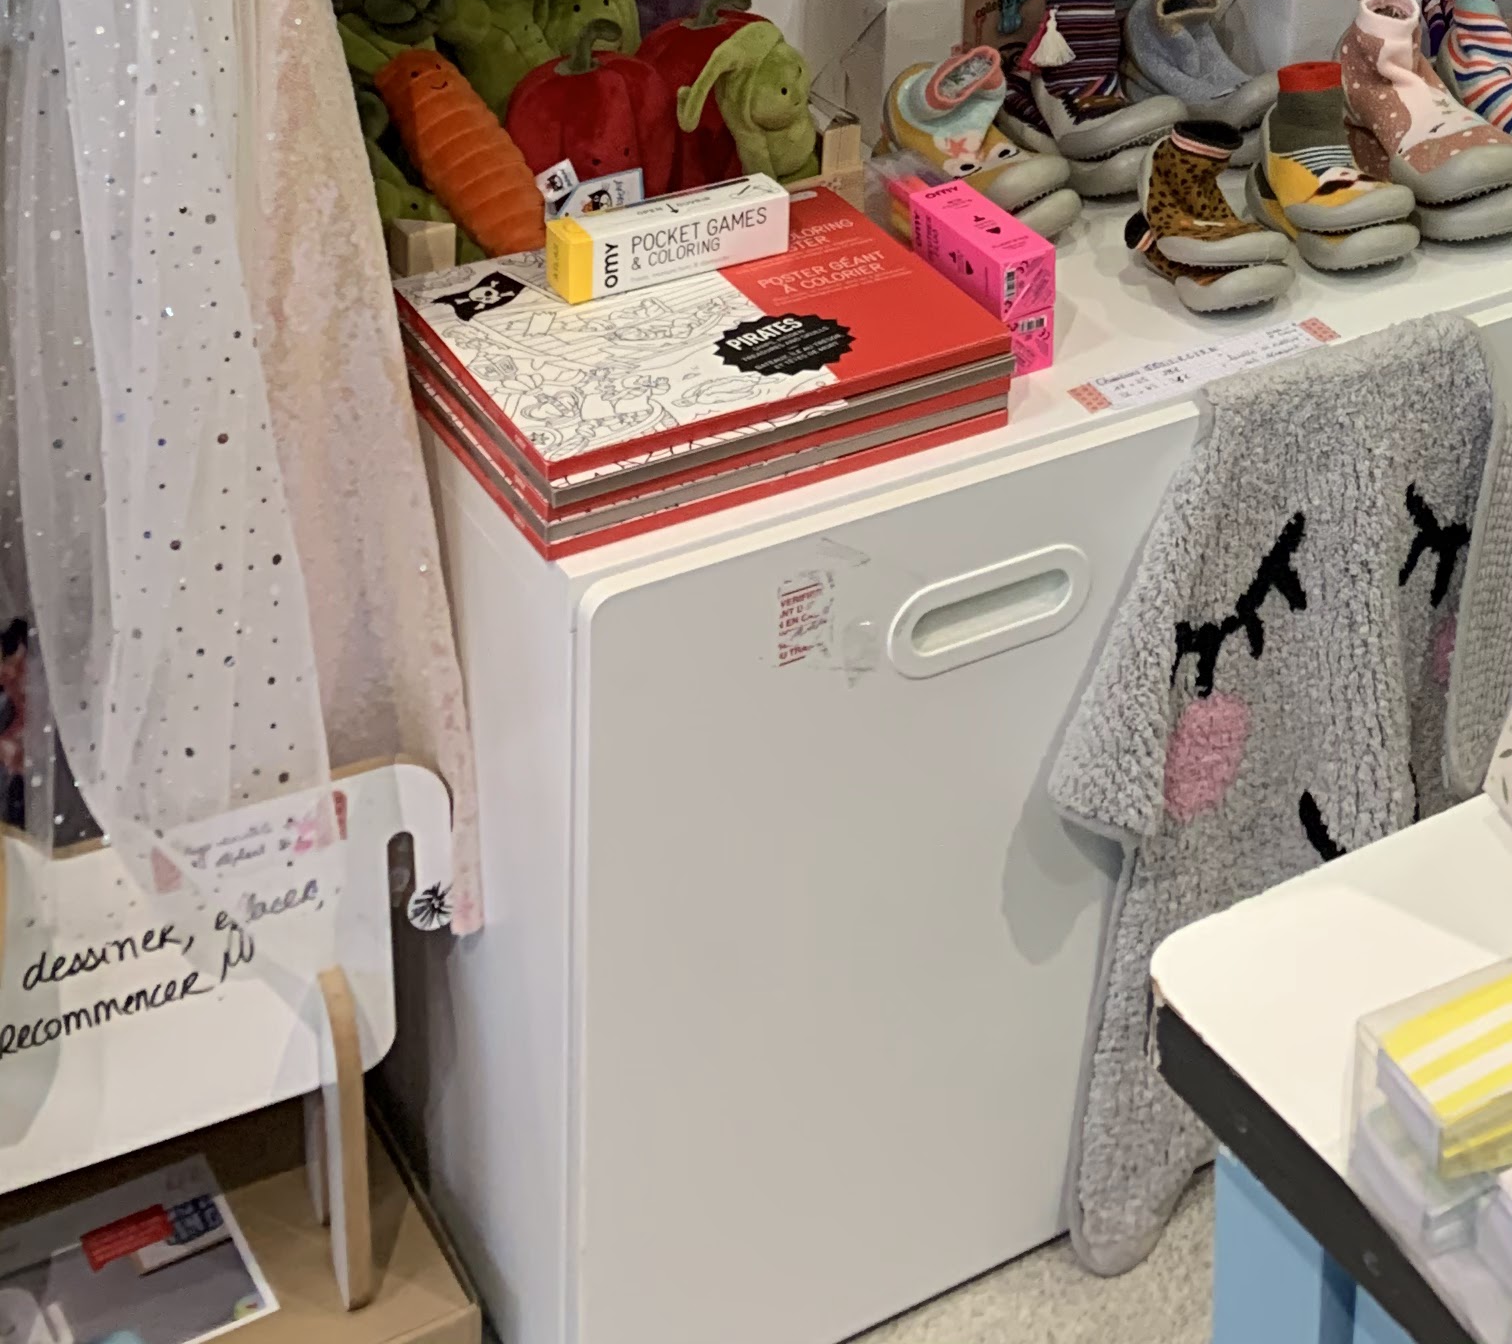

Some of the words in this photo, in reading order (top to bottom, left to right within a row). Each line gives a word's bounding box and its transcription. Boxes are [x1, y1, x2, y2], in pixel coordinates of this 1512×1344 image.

[631, 220, 701, 254] POCKET
[706, 205, 768, 237] GAMES
[631, 256, 642, 271] &
[647, 236, 721, 269] COLORING
[757, 256, 832, 290] POSTER
[800, 263, 883, 290] COLORIER
[726, 316, 803, 350] PIRATES
